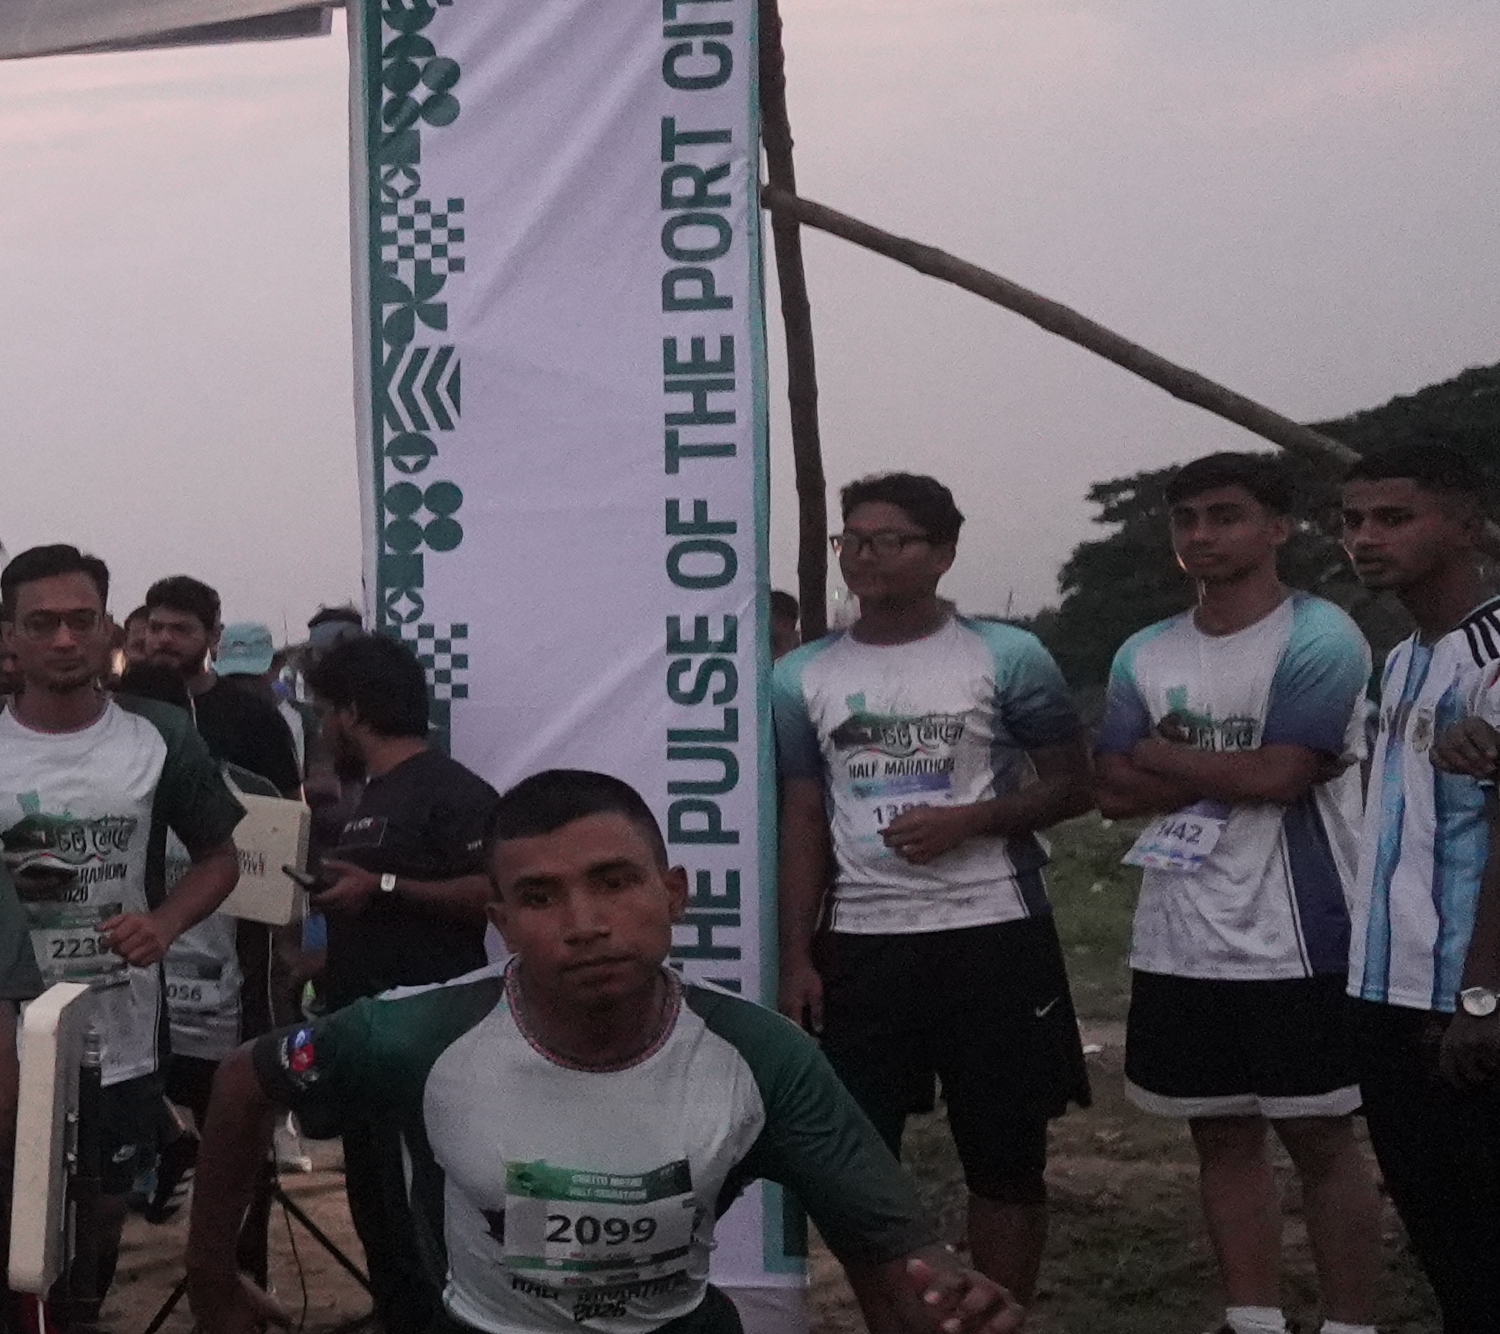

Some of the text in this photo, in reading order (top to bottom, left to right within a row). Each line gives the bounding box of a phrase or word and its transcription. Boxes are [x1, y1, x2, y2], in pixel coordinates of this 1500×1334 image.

[661, 116, 733, 313] PORT
[663, 335, 737, 474] THE
[666, 497, 738, 590] OF
[666, 614, 740, 845] PULSE
[669, 869, 741, 993] HE
[547, 1214, 658, 1247] 2099
